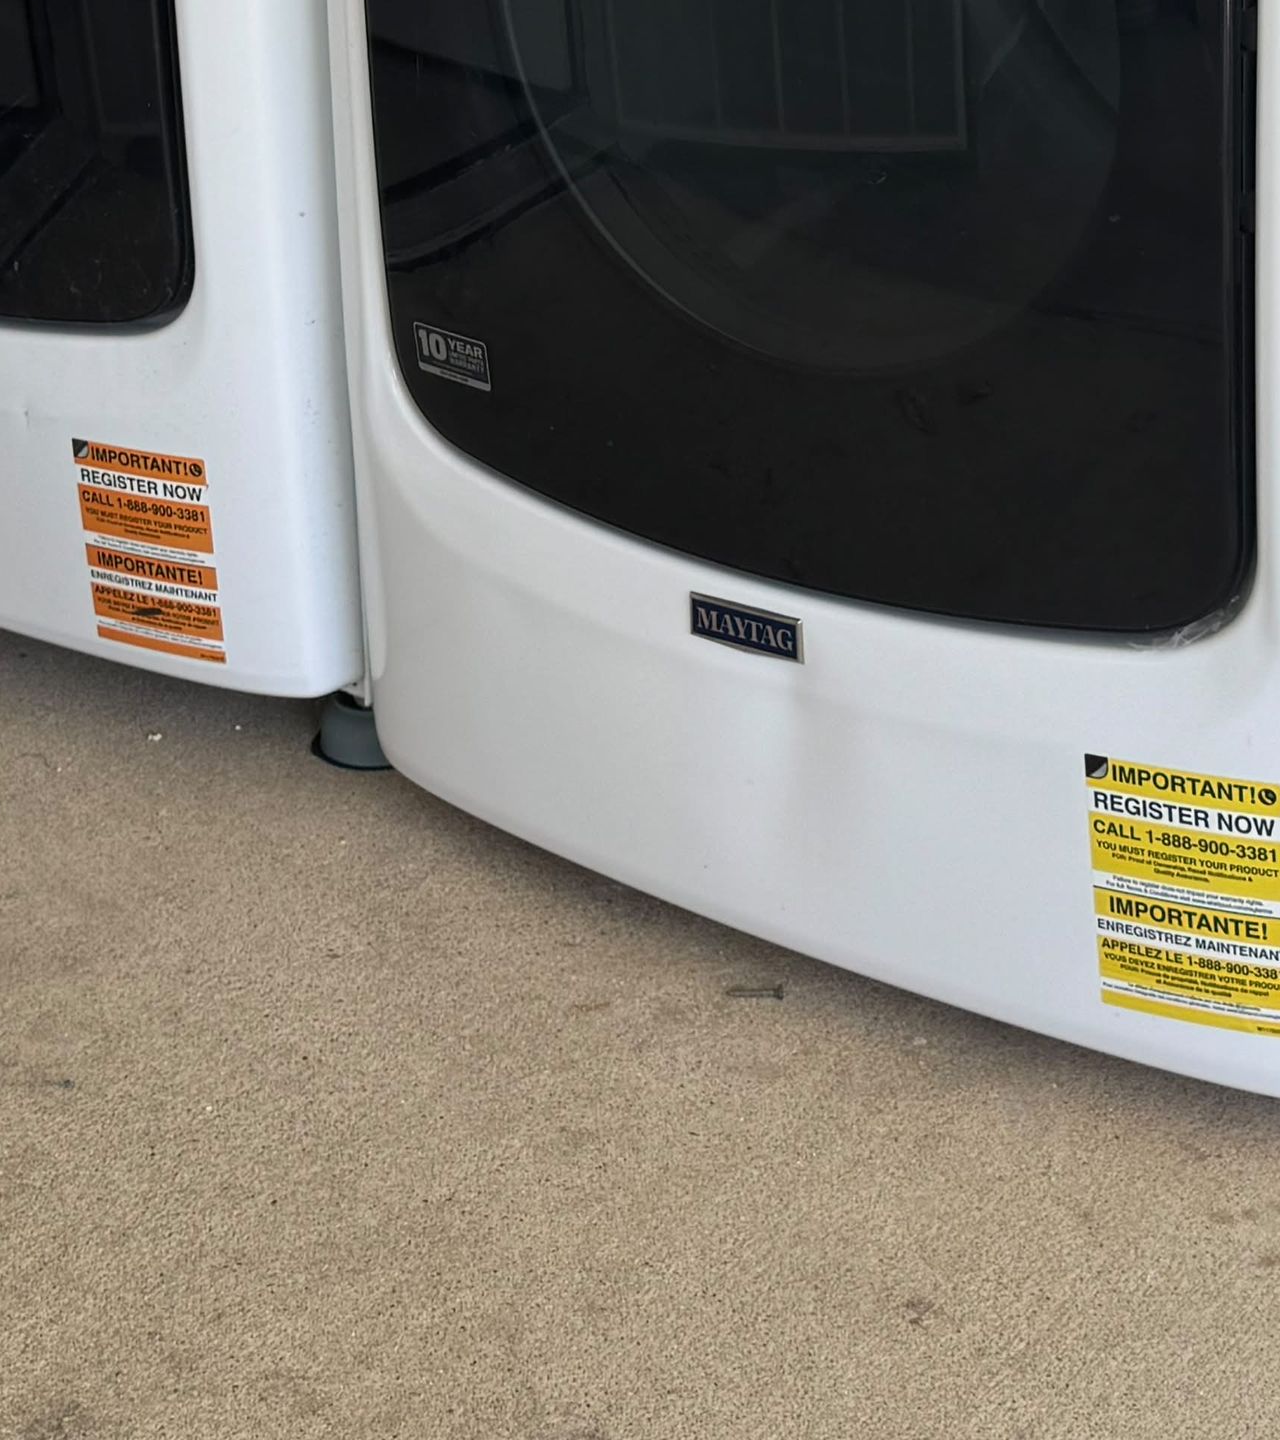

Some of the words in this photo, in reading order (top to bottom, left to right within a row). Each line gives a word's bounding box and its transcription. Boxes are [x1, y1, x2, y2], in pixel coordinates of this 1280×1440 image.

[418, 329, 447, 360] 10
[448, 338, 483, 359] YEAR
[91, 446, 188, 476] IMPORTANT!
[81, 468, 158, 495] REGISTER
[164, 483, 202, 502] NOW
[82, 490, 114, 507] CALL
[117, 498, 205, 522] 1-888-900-3381
[174, 523, 208, 535] PRODUCT
[97, 551, 202, 585] IMPORTANTE!
[91, 570, 152, 591] ENREGISTREZ
[155, 584, 218, 602] MAINTENANT
[95, 584, 135, 602] APPELEZ
[137, 594, 149, 605] LE
[696, 606, 793, 651] MAYTAG
[1111, 764, 1257, 804] IMPORTANT!
[1093, 790, 1209, 828] REGISTER
[1217, 813, 1275, 837] NOW
[1093, 819, 1141, 841] CALL
[1145, 829, 1277, 863] 1-888-900-3381
[1096, 839, 1116, 851] YOU
[1119, 844, 1145, 856] MUST
[1148, 850, 1197, 866] REGISTER
[1199, 859, 1227, 871] YOUR
[1229, 864, 1279, 877] PRODUCT
[1097, 918, 1191, 947] ENREGISTREZ
[1109, 896, 1268, 940] IMPORTANTE!
[1101, 938, 1162, 961] APPELEZ
[1166, 951, 1183, 964] LE
[1104, 951, 1126, 963] VOUS
[1128, 957, 1155, 969] DEVEZ
[1157, 963, 1216, 980] ENREGISTRER
[1218, 974, 1247, 986] VOTRE
